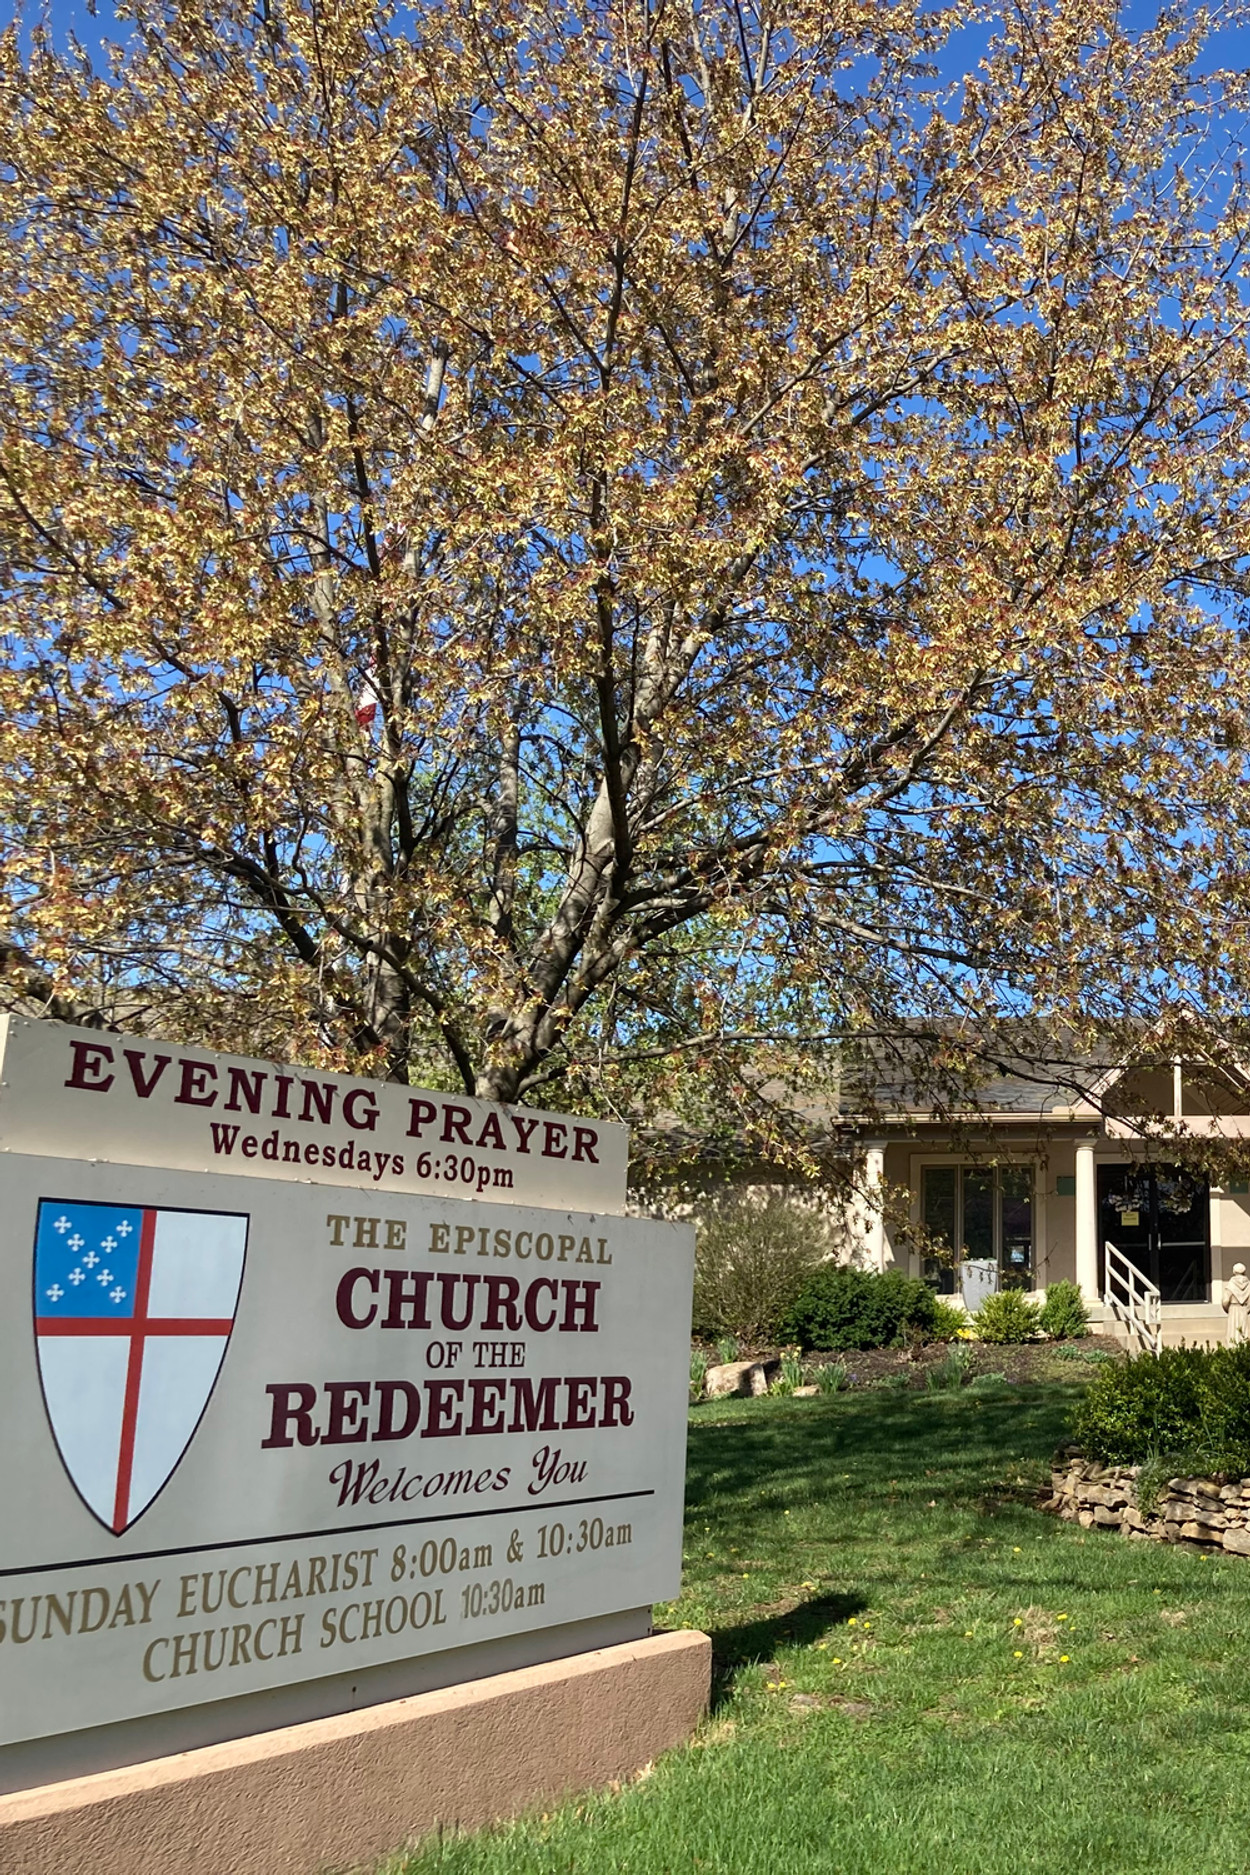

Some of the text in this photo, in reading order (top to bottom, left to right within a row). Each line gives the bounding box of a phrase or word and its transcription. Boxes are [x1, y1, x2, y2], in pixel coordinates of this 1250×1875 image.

[64, 1040, 600, 1164] EVENING PRAYER
[210, 1122, 514, 1192] Wednesdays 6:30pm
[327, 1214, 612, 1265] THE EPISCOPAL
[335, 1266, 601, 1333] CHURCH
[426, 1341, 526, 1369] OF THE
[261, 1376, 635, 1449] REDEEMER
[328, 1445, 588, 1510] Welcomes You
[0, 1518, 633, 1645] UNDAY EUCHARIST 8:00am & 10:30am
[143, 1578, 546, 1683] CHURCH SCHOOL 10:30am
